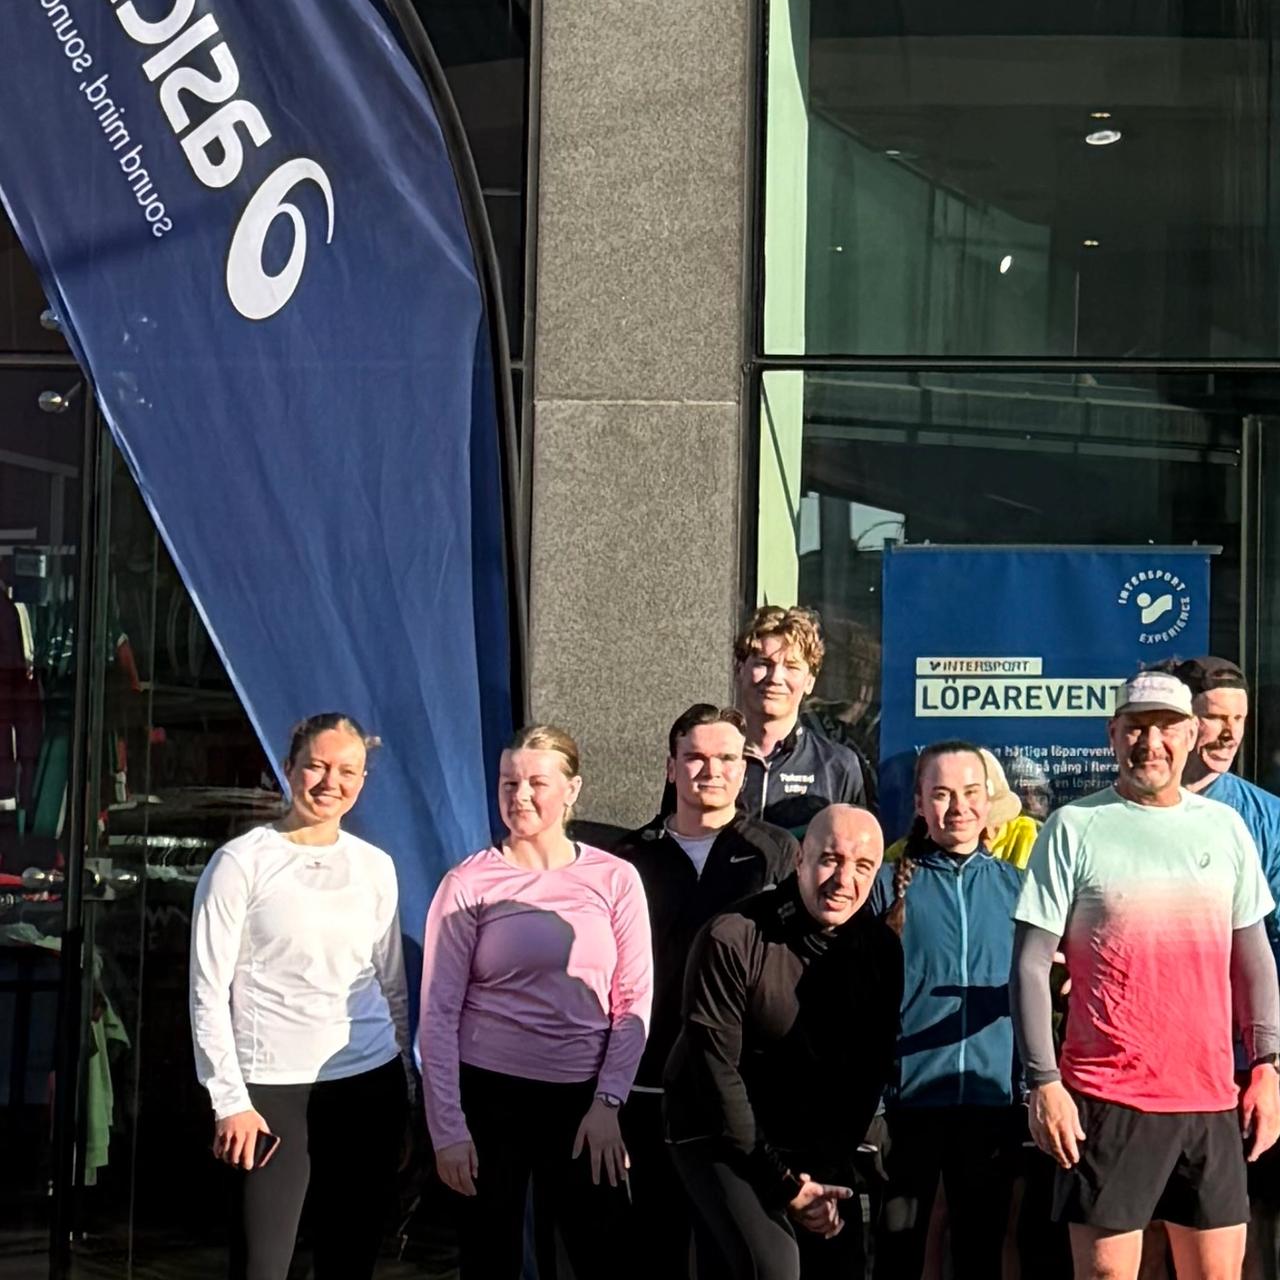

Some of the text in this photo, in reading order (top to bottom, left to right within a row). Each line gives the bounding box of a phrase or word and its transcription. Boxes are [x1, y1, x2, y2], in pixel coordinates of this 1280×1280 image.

[1118, 569, 1186, 605] INTERSPORT
[1139, 596, 1190, 644] EXPERIENCE
[943, 661, 1030, 673] INTERSPORT
[1052, 761, 1082, 773] gång
